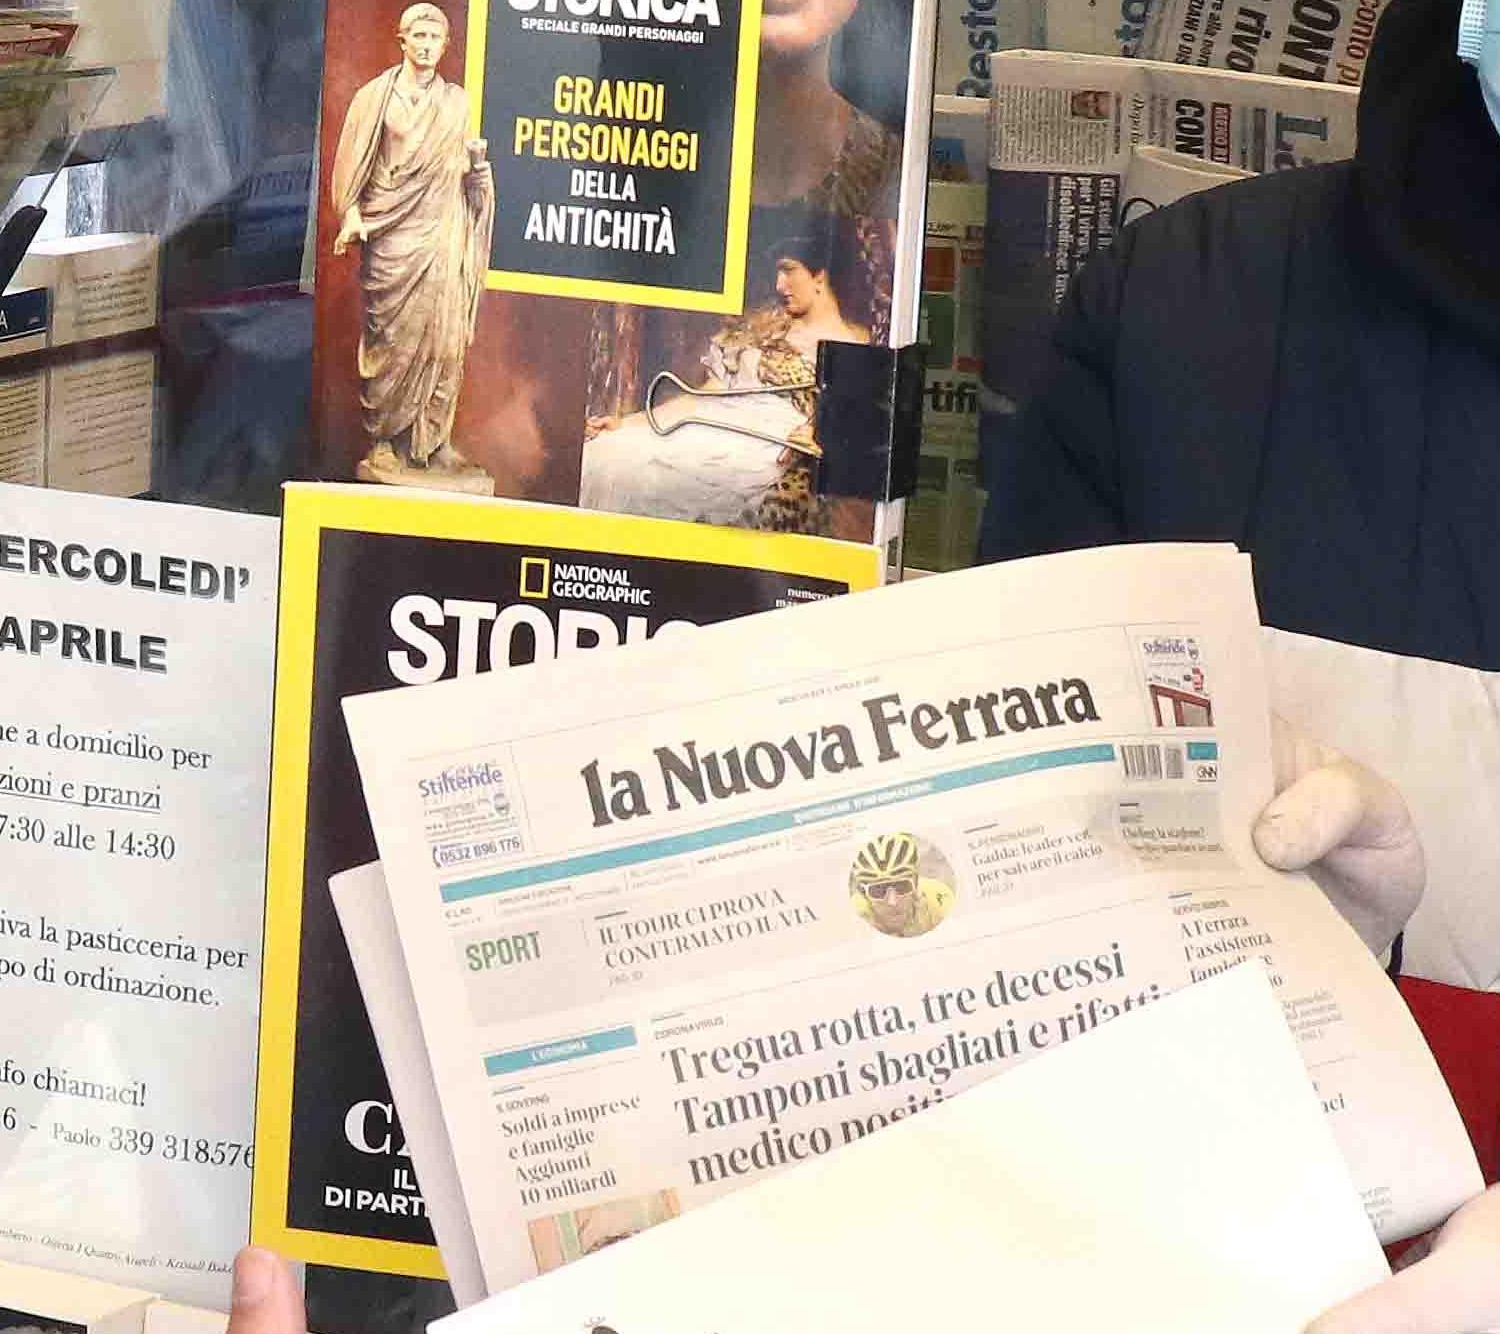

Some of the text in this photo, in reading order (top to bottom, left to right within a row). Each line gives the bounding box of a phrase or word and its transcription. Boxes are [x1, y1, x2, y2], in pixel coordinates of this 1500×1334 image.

[522, 17, 704, 44] SPECIALE GRANDI PERSONAGGI
[554, 75, 664, 122] GRANDI
[514, 116, 698, 171] PERSONAGGI
[571, 168, 637, 202] DELLA
[524, 203, 676, 254] ANTICHITÀ
[551, 581, 651, 606] GEOGRAPHIC
[554, 564, 630, 588] NATIONAL
[26, 727, 39, 746] a
[46, 724, 164, 762] domicilio
[171, 745, 212, 772] per
[581, 676, 1102, 828] la Nuova Ferrara
[61, 781, 76, 798] e
[82, 779, 162, 811] pranzi
[53, 821, 97, 850] alle
[106, 828, 176, 860] 14:30
[40, 916, 59, 942] la
[65, 922, 197, 966] pasticceria
[205, 945, 249, 970] per
[465, 931, 543, 972] SPORT
[33, 955, 57, 985] di
[63, 964, 221, 1007] ordinazione.
[661, 1028, 805, 1086] Tregua
[810, 1004, 919, 1051] rotta,
[922, 987, 978, 1022] tre
[985, 943, 1127, 1006] decessi
[33, 1064, 146, 1108] chiamaci!
[674, 1018, 1022, 1138] Tamponi sbagliati
[53, 1122, 101, 1147] Paolo
[109, 1126, 154, 1156] 339
[688, 1120, 834, 1186] medico
